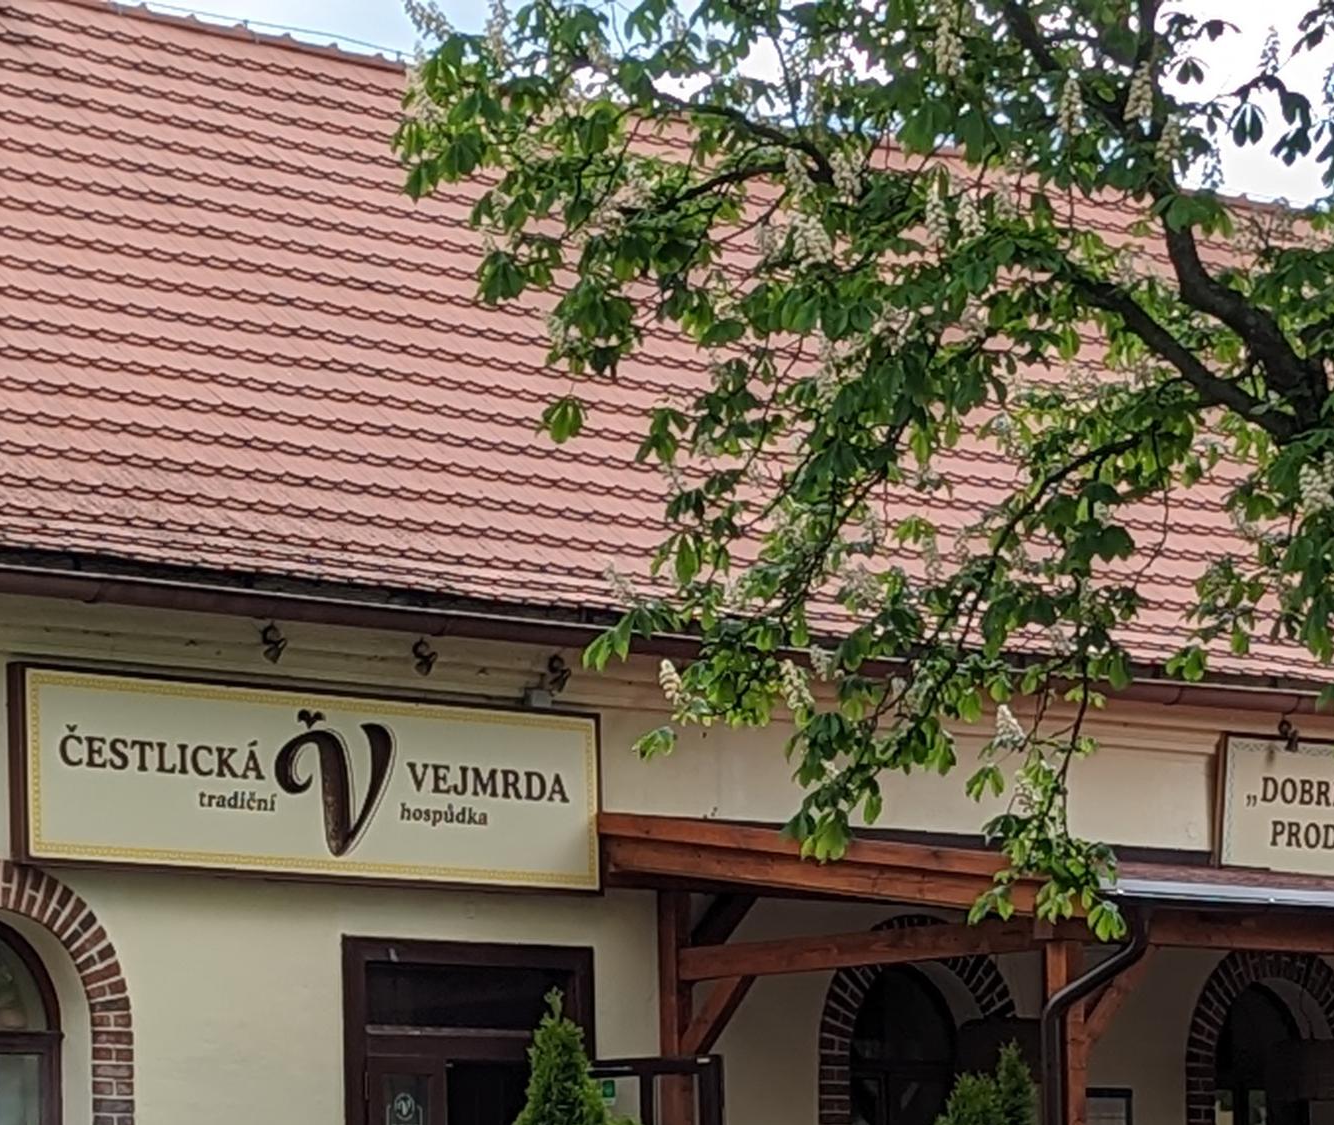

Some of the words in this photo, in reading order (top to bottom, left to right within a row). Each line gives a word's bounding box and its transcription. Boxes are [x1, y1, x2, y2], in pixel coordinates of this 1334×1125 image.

[59, 724, 266, 781] ČESTLICKÁ
[406, 762, 570, 804] VEJMRDA
[198, 790, 276, 813] tradiční
[399, 801, 489, 827] hospůdka
